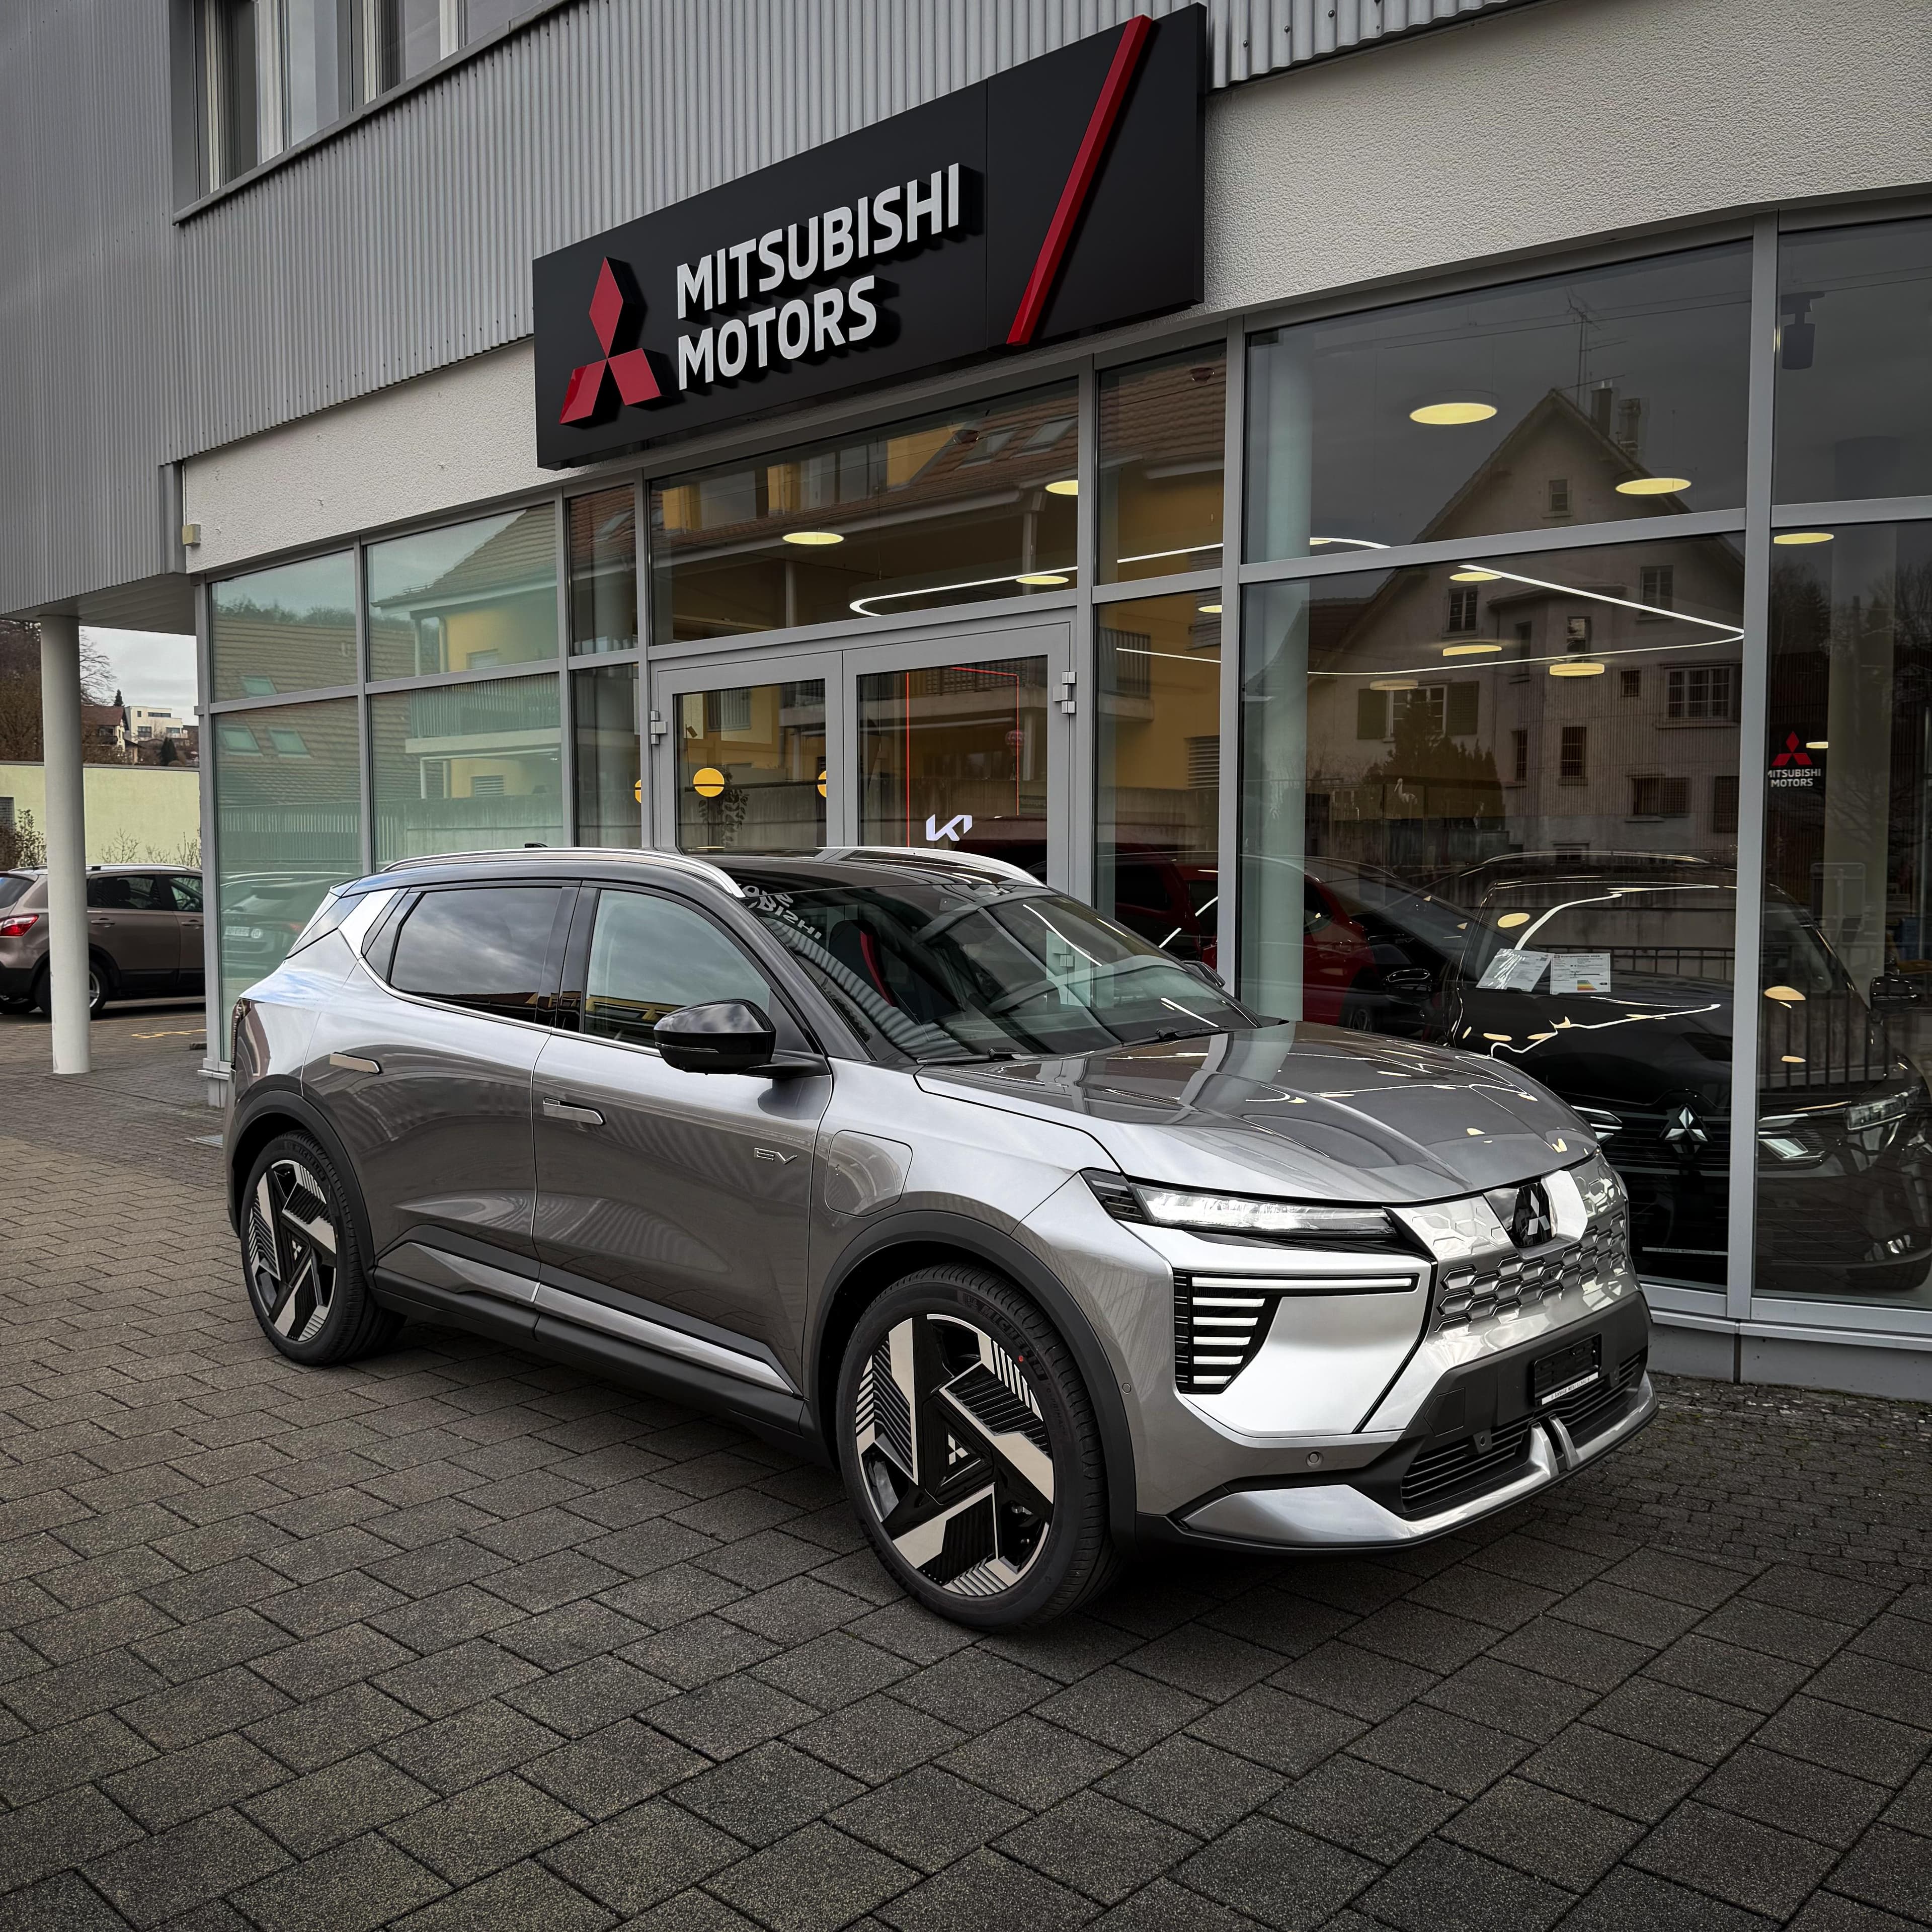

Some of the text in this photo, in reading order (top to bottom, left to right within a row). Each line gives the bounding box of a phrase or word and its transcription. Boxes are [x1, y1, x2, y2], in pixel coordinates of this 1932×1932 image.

[677, 162, 960, 320] MITSUBISHI
[678, 275, 877, 391] MOTORS
[1770, 778, 1813, 787] MOTORS
[754, 1147, 798, 1165] EV
[979, 1304, 1047, 1379] MICHELIN
